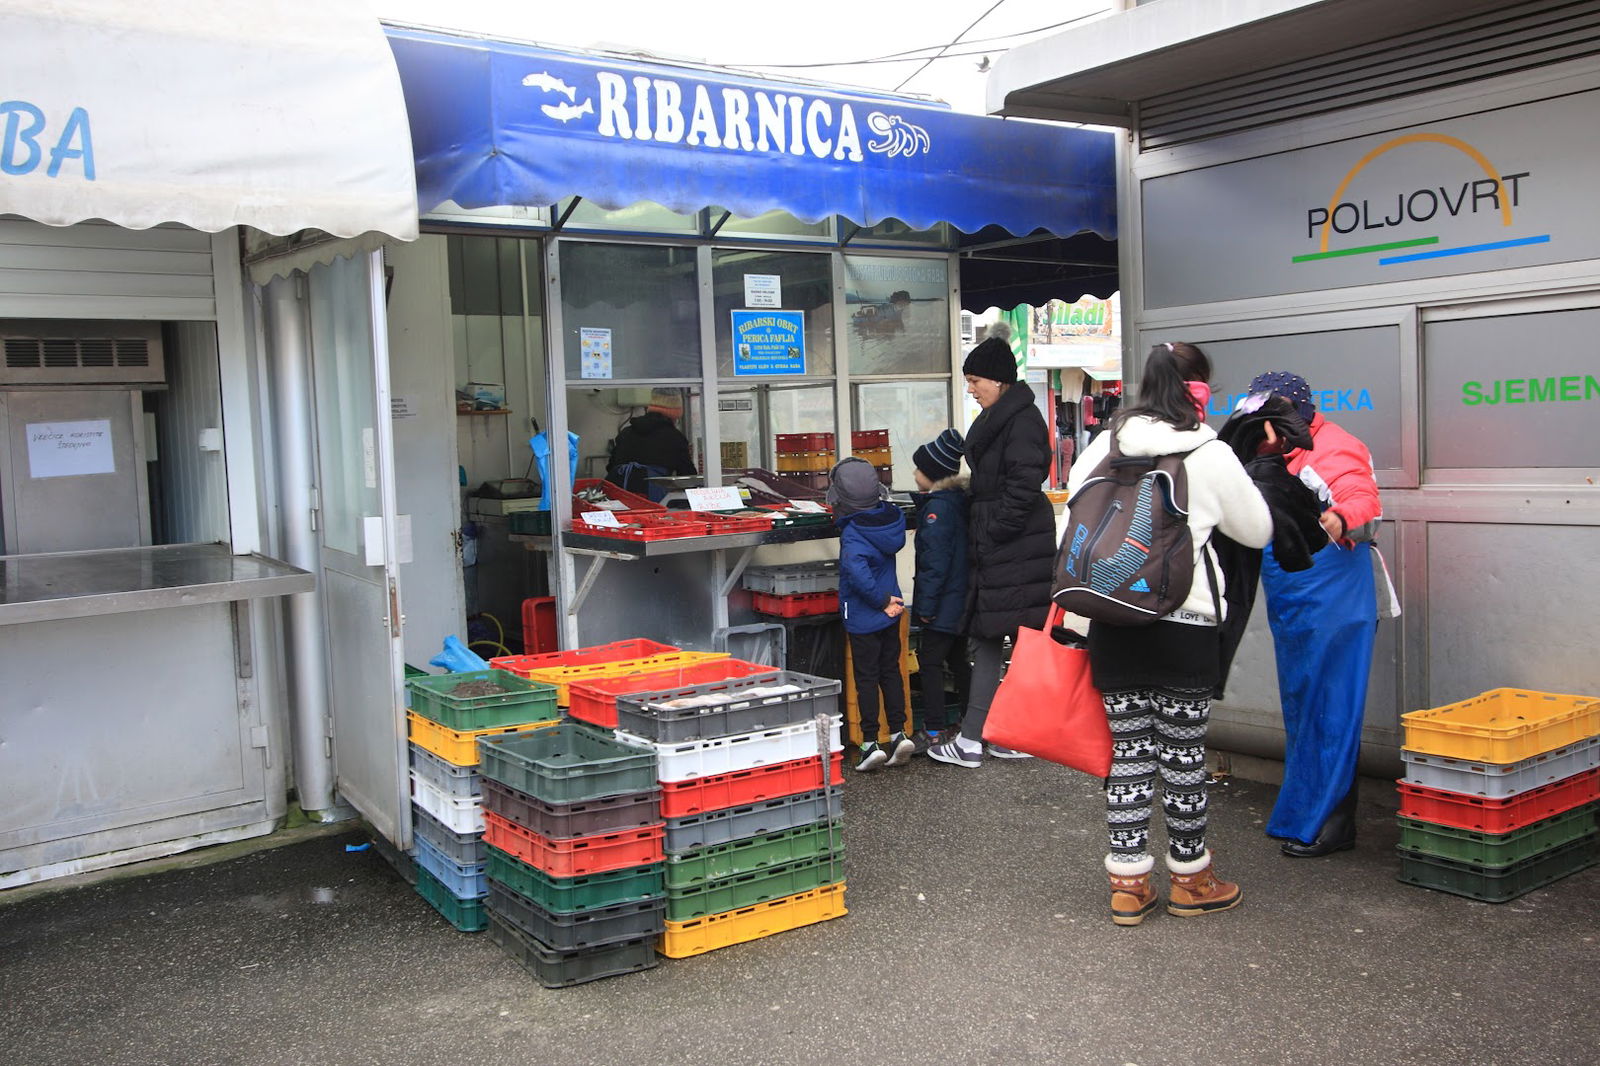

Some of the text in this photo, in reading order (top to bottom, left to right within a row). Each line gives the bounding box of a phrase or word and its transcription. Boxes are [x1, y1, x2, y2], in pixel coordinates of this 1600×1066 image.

[0, 101, 96, 181] BA
[596, 71, 864, 163] RIBARNICA
[1307, 172, 1530, 238] POLJOVRT
[738, 317, 798, 334] RIBARSKI OBRT
